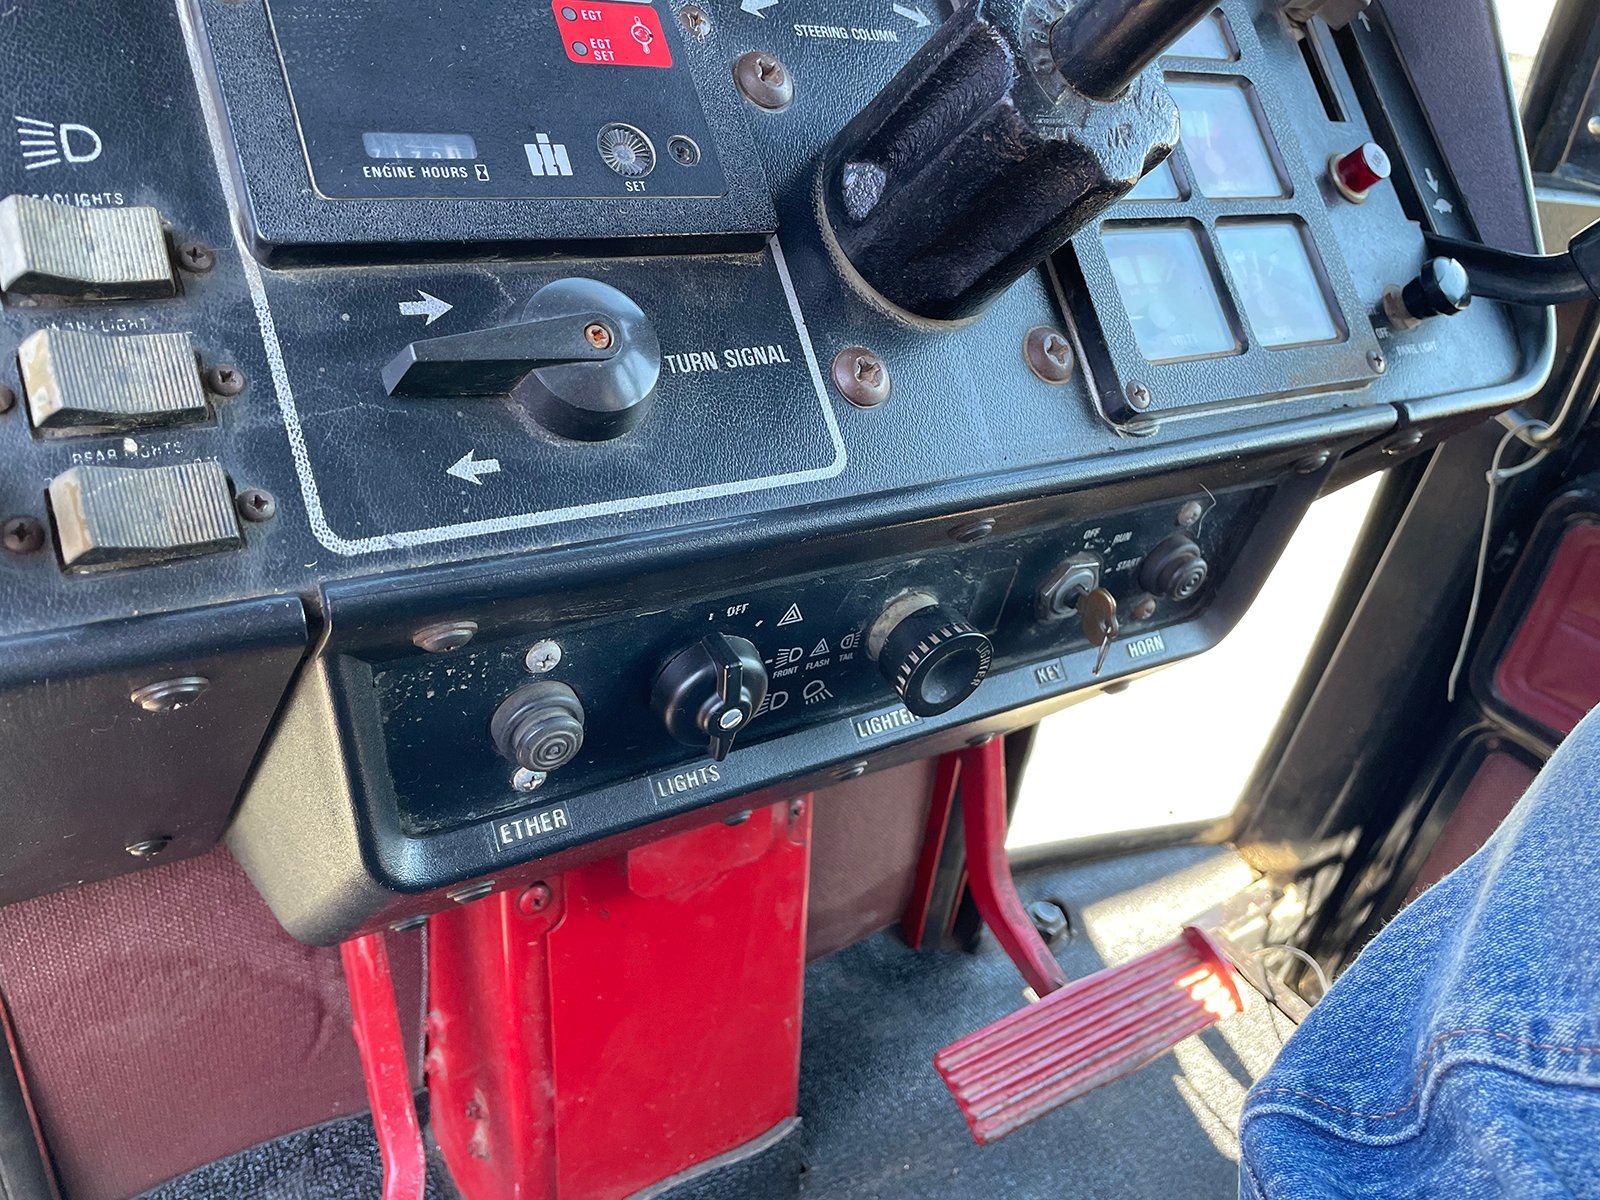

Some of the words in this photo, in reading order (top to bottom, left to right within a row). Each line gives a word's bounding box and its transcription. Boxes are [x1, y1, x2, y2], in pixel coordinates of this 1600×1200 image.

[581, 9, 604, 22] EGT
[793, 24, 849, 40] STEERING
[851, 28, 898, 42] COLUMN
[590, 38, 612, 50] EGT
[594, 50, 616, 62] SET
[362, 166, 416, 178] ENGINE
[421, 166, 468, 178] HOURS
[625, 181, 646, 193] SET
[664, 350, 719, 374] TURN
[724, 344, 791, 369] SIGNAL
[1083, 527, 1101, 540] OFF
[1111, 531, 1133, 546] RUN
[1115, 556, 1142, 572] START
[726, 602, 750, 617] OFF
[1127, 634, 1165, 659] HORN
[805, 657, 831, 671] FLASH
[839, 651, 855, 662] TAIL
[969, 640, 992, 687] LIGHTER
[772, 665, 800, 680] FRONT
[1036, 665, 1062, 685] KEY
[657, 763, 722, 798] LIGHTS
[499, 807, 568, 844] ETHER
